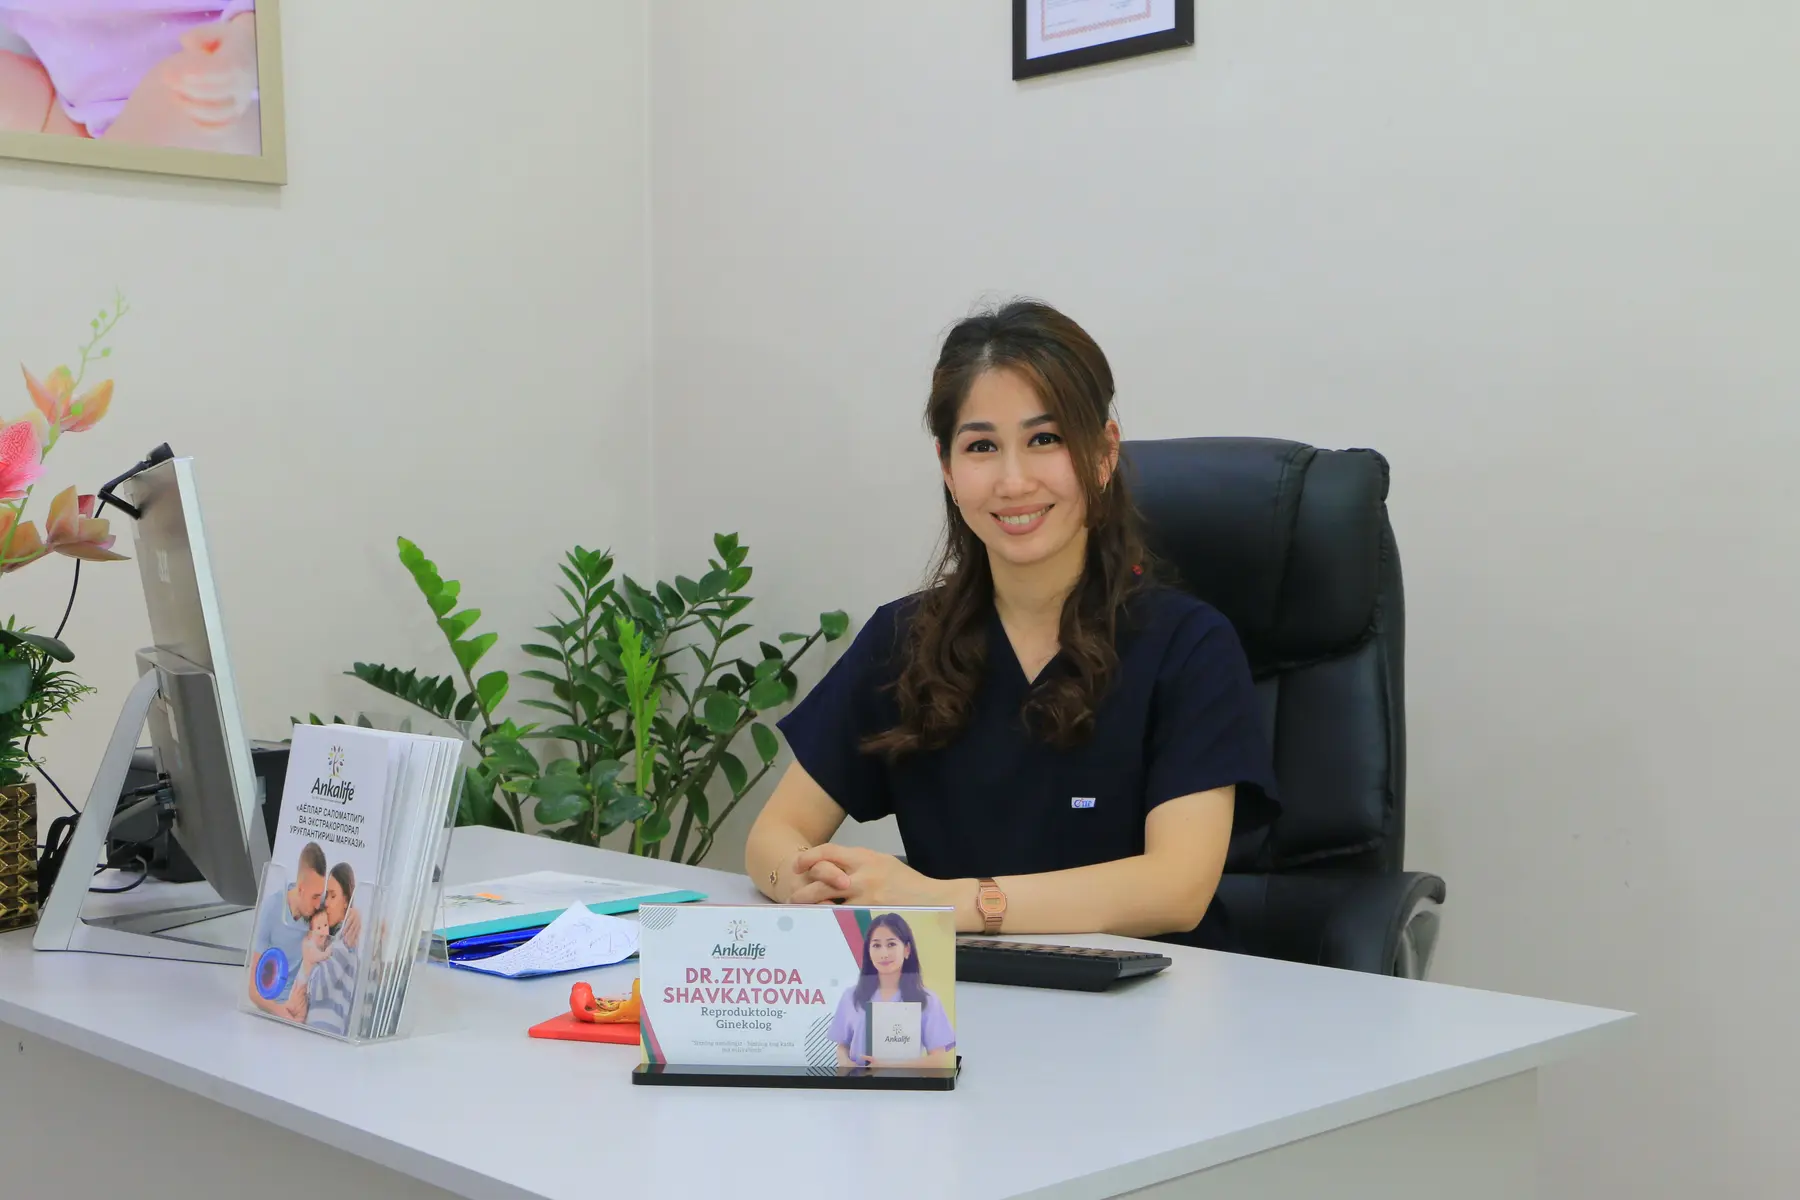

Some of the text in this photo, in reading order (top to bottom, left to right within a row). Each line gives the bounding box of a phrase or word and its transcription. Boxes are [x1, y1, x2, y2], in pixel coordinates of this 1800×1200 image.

[311, 777, 355, 805] Ankalife
[323, 808, 365, 824] САЛОМАТЛИГИ
[299, 815, 360, 835] ВА ЭКСТРАКОРПОРАЛ
[711, 943, 766, 960] Ankalife
[686, 967, 803, 985] DR.ZIYODA
[663, 987, 826, 1005] SHAVKATOVNA
[701, 1007, 787, 1018] Reproduktolog-
[716, 1020, 772, 1031] Ginekolog
[884, 1035, 911, 1045] Ankalife
